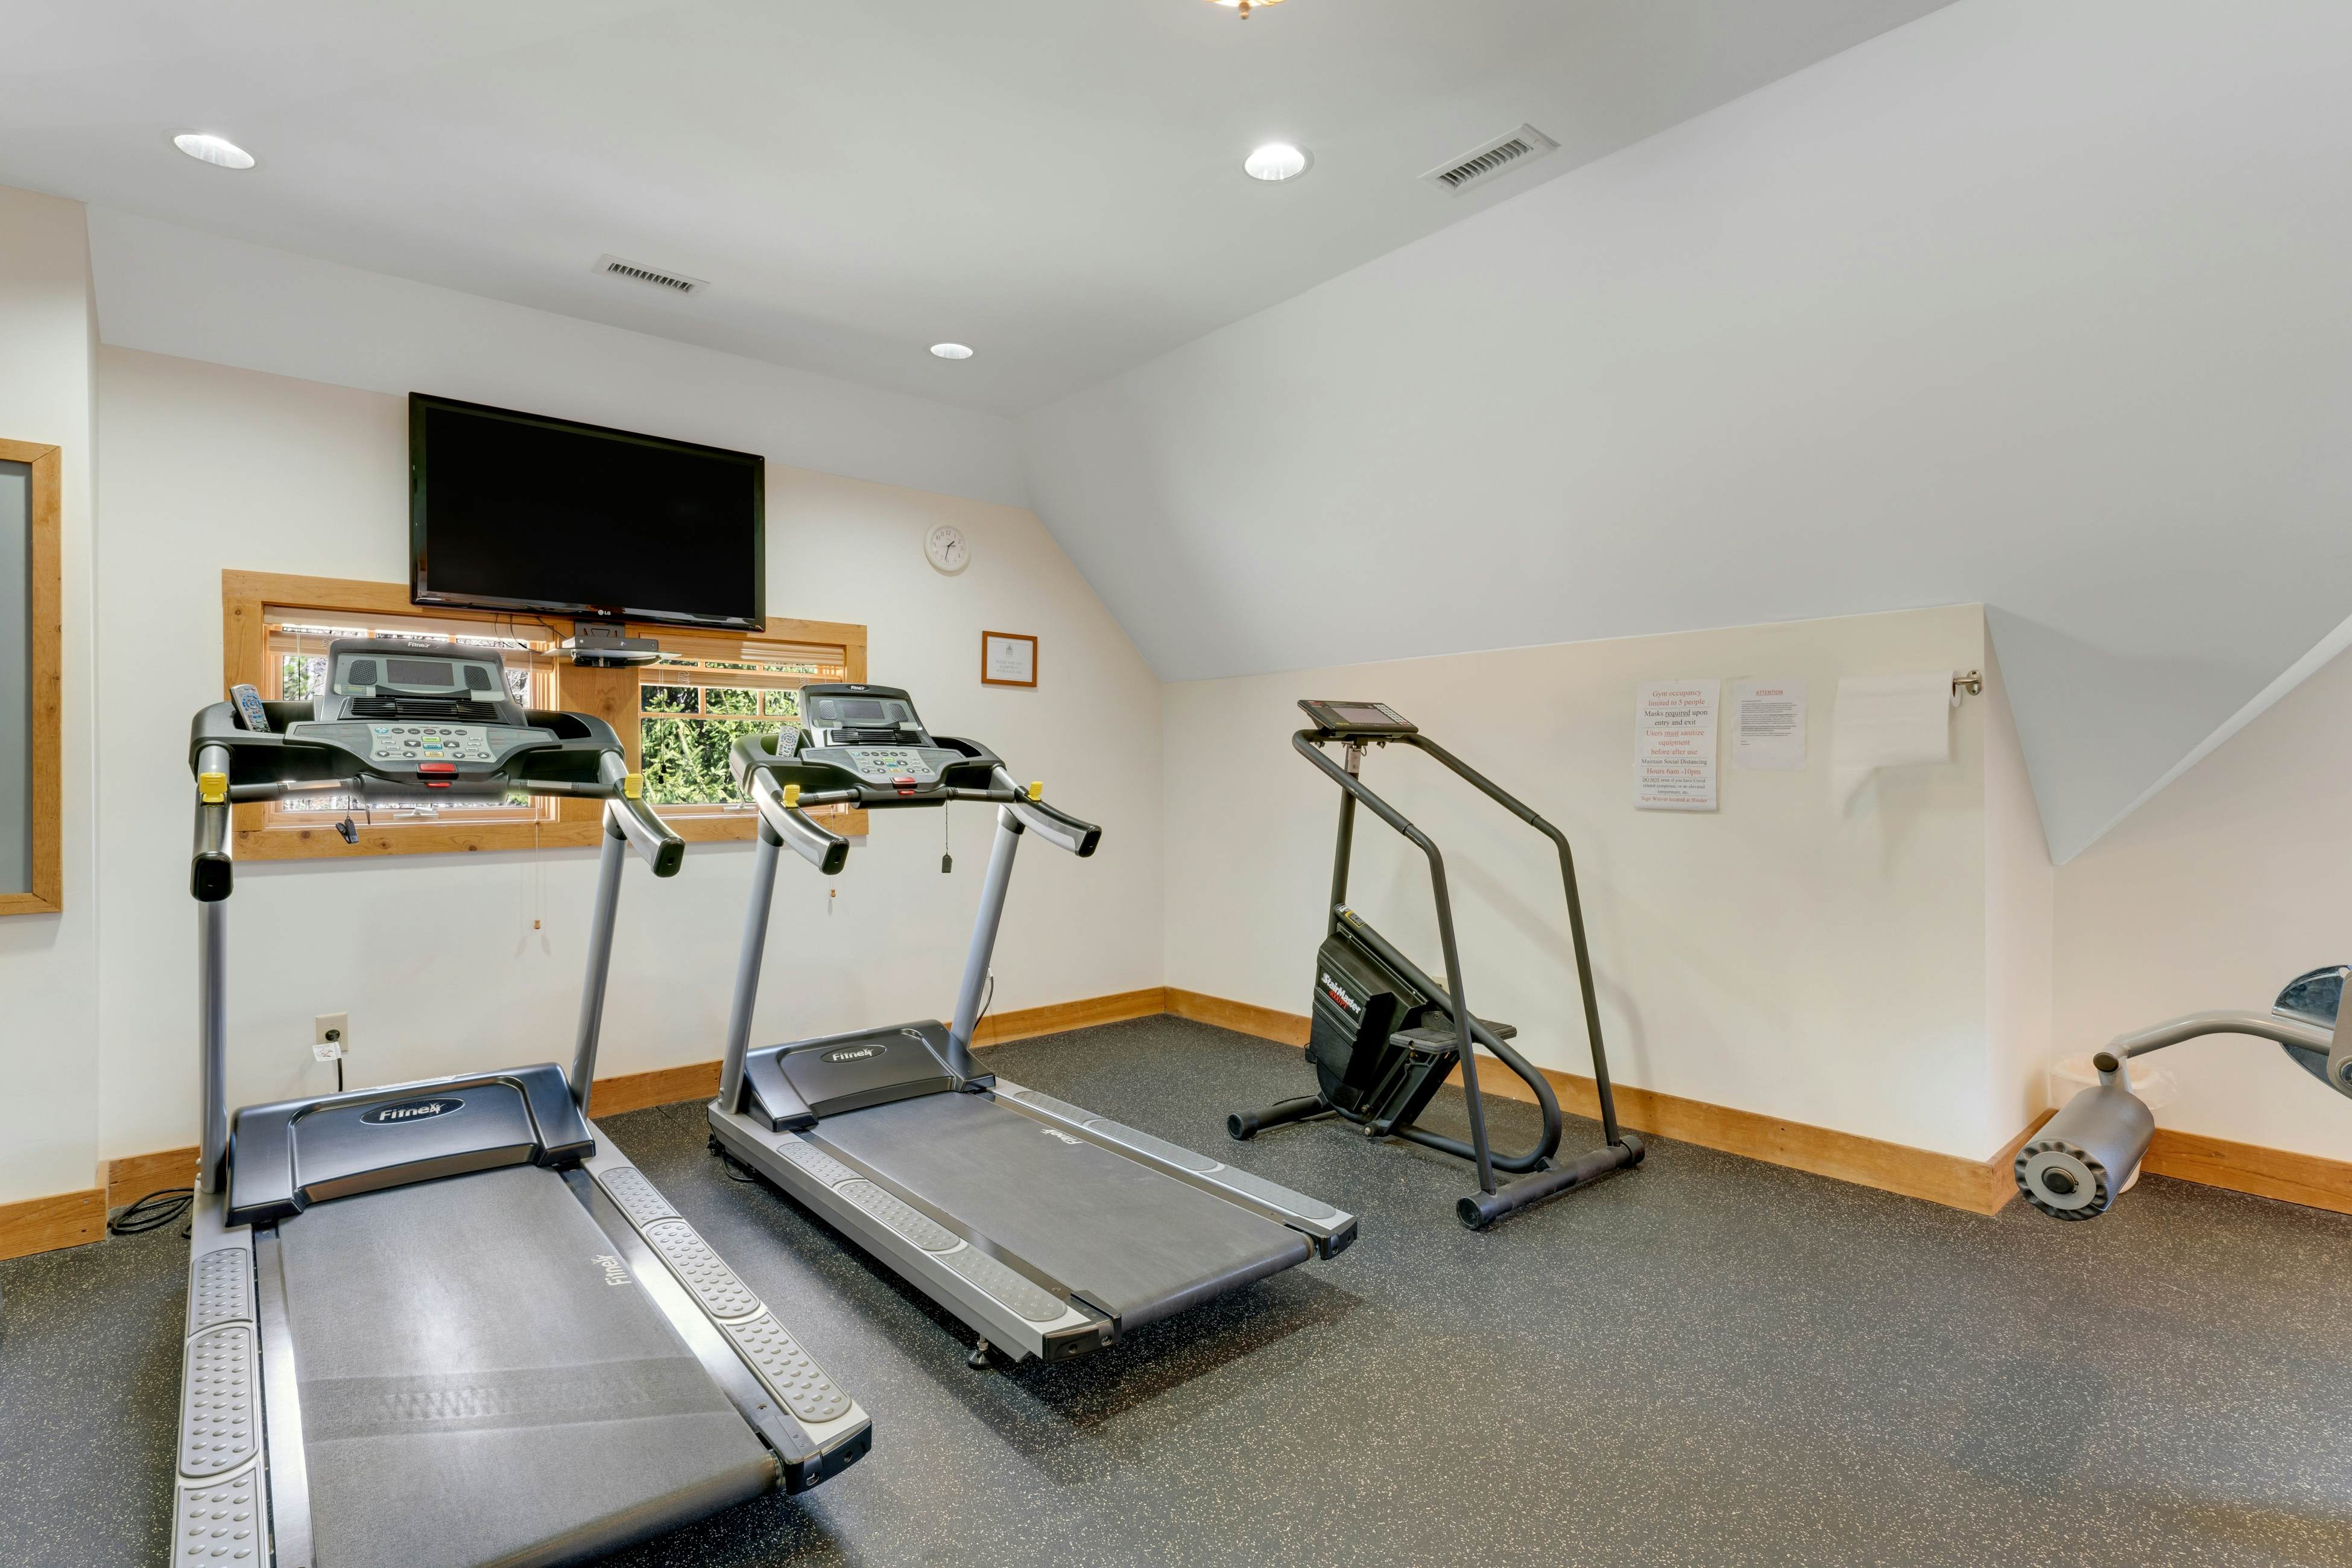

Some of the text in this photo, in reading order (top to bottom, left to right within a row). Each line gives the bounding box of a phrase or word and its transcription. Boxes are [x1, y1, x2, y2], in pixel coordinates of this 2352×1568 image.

[1321, 972, 1361, 1014] StairMaster
[832, 1048, 873, 1061] Fitnex
[379, 1102, 446, 1121] Fitnex
[1040, 1129, 1084, 1145] Fitnex
[590, 1254, 632, 1286] Fitnex
